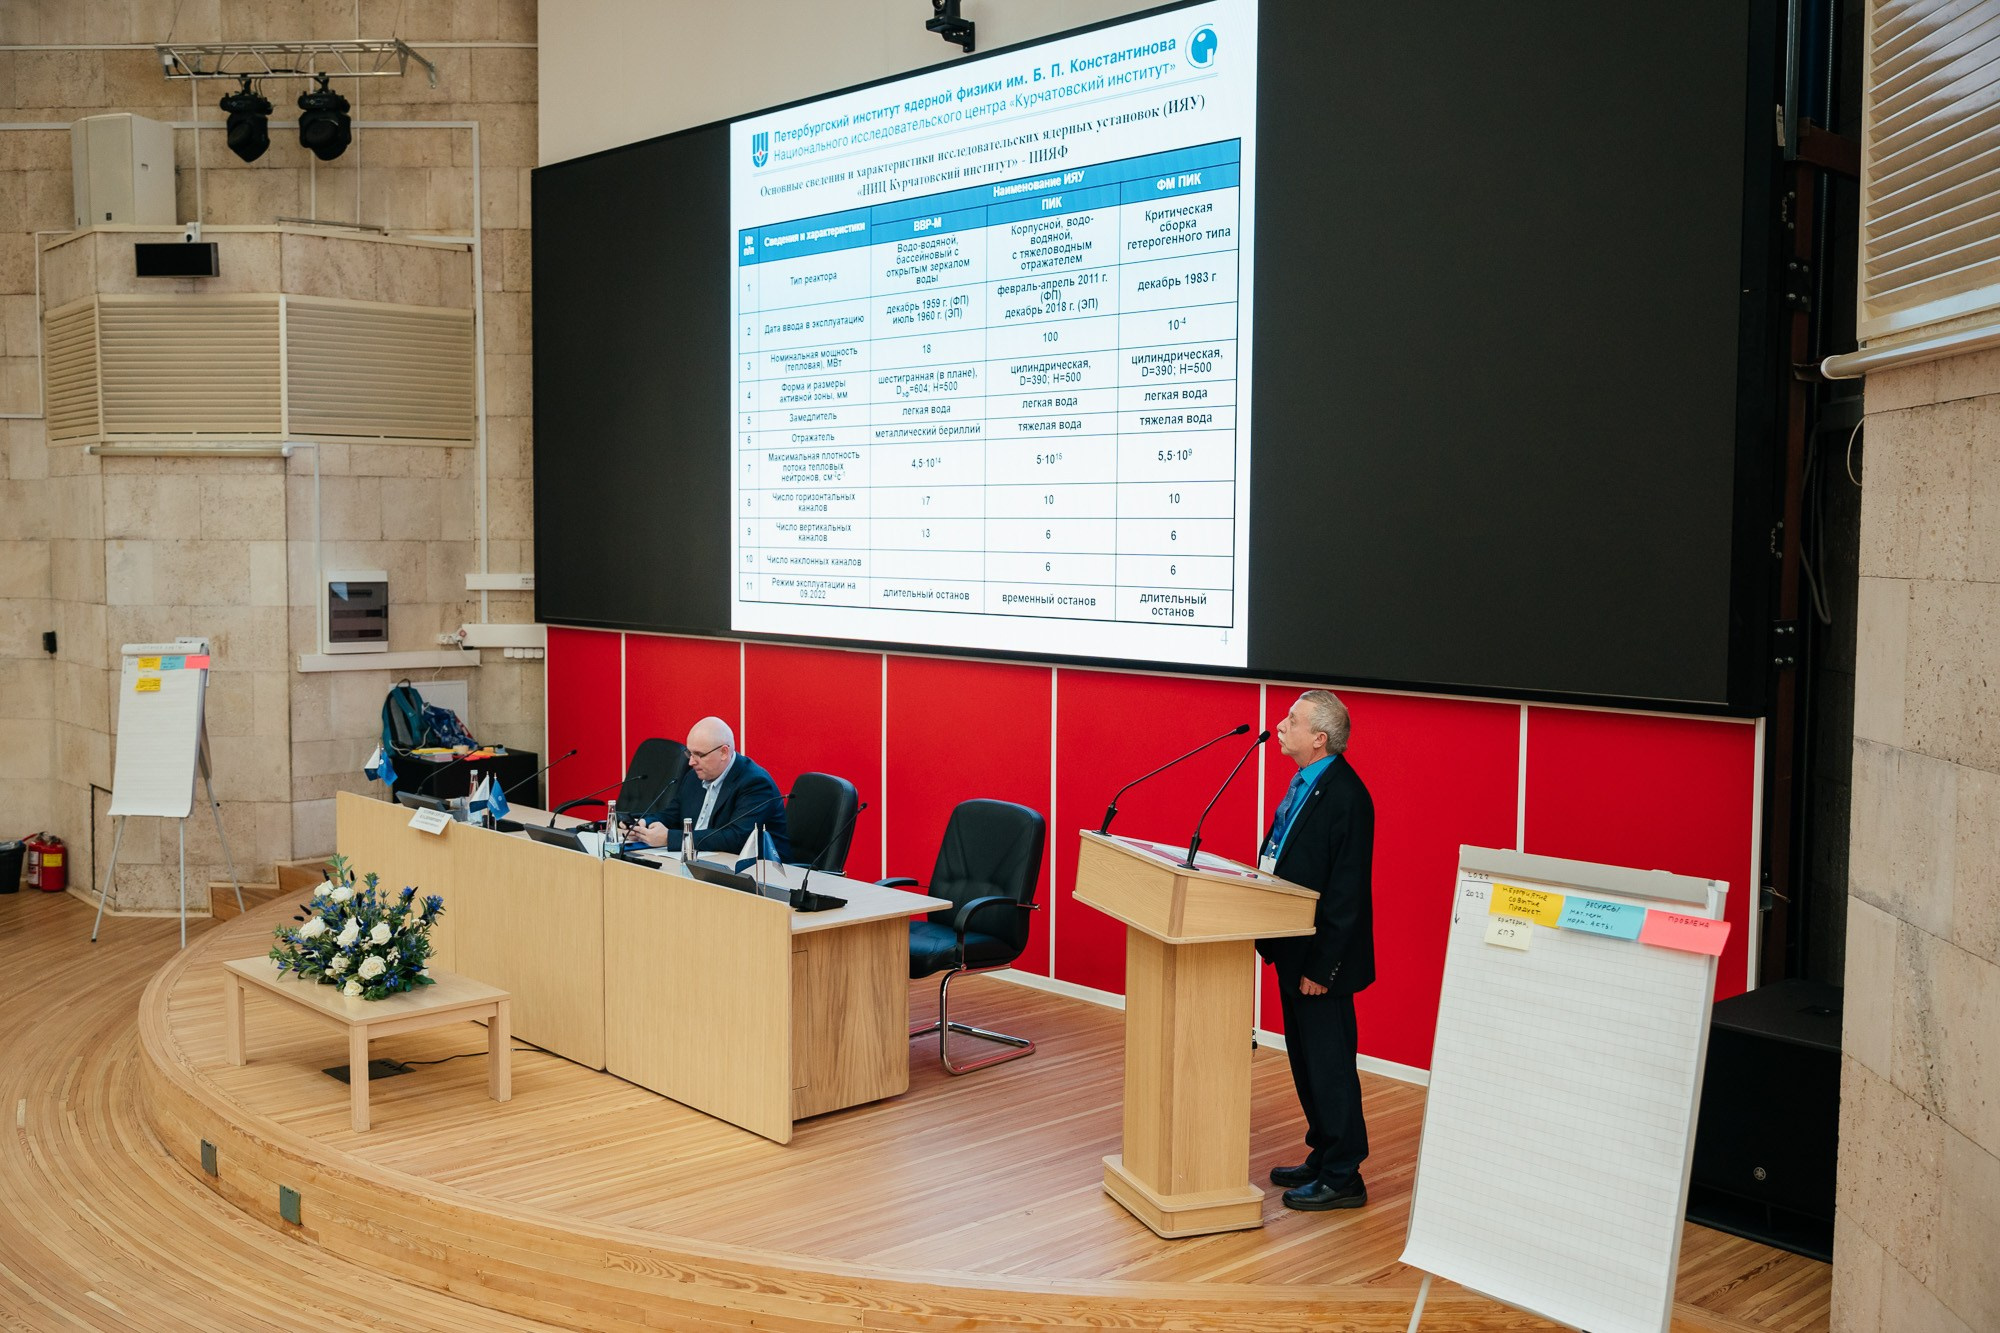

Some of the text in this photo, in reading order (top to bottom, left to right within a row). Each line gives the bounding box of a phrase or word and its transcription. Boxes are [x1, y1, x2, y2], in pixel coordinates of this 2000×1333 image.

[774, 38, 1176, 142] Петербургский институт ядерной физики им. Б. П. Константинова
[774, 62, 1175, 160] Национального исследовательского центра «Курчатовский институт»
[760, 182, 803, 196] Основные
[805, 172, 844, 187] сведения
[856, 154, 934, 179] характеристики
[938, 133, 1039, 160] исследовательских
[1042, 122, 1092, 139] ядерных
[1096, 107, 1159, 132] установок
[1163, 94, 1205, 117] (ИЯУ)
[889, 169, 959, 191] Курчатовский
[963, 159, 1017, 176] институт»
[1029, 145, 1068, 163] ПИЯФ
[993, 170, 1084, 197] Наименование ИЯУ
[1156, 172, 1201, 190] ФМ ПИК
[1041, 196, 1062, 210] ПИК
[1145, 203, 1212, 222] Критическая
[913, 216, 941, 231] ВВР-М
[1011, 215, 1093, 236] Корпусной, водо-
[1159, 219, 1197, 232] сборка
[763, 233, 799, 247] Сведения
[806, 222, 865, 241] характеристики
[1030, 228, 1072, 244] водяной,
[1127, 227, 1230, 250] гетерогенного типа
[897, 234, 958, 253] Водо-водяной,
[1019, 241, 1091, 258] тяжеловодным
[896, 247, 952, 264] бассейновый
[1020, 254, 1082, 271] отражателем
[886, 258, 969, 277] открытым зеркалом
[790, 272, 837, 285] Тип реактора
[916, 274, 938, 284] воды
[997, 278, 1075, 297] февраль-апрель
[1077, 272, 1098, 285] 2011
[1137, 276, 1181, 291] декабрь
[1184, 271, 1208, 284] 1983
[1040, 289, 1061, 303] (ФП)
[886, 303, 919, 314] декабрь
[922, 298, 940, 309] 1959
[950, 294, 969, 308] (ФП)
[1004, 305, 1042, 319] декабрь
[1045, 301, 1066, 313] 2018
[1077, 297, 1098, 312] (ЭП)
[892, 315, 914, 324] июль
[917, 310, 935, 321] 1960
[944, 307, 962, 320] (ЭП)
[764, 324, 780, 334] Дата
[782, 322, 803, 331] ввода
[811, 315, 864, 328] эксплуатацию
[1042, 331, 1058, 342] 100
[770, 347, 857, 362] Номинальная мощность
[1131, 349, 1223, 365] цилиндрическая,
[826, 358, 842, 367] МВт
[1010, 359, 1090, 374] цилиндрическая,
[878, 372, 934, 384] шестигранная
[947, 367, 977, 378] плане),
[781, 383, 804, 392] Форма
[813, 380, 845, 391] размеры
[779, 391, 811, 402] активной
[1144, 389, 1207, 401] легкая вода
[1022, 397, 1077, 408] легкая вода
[789, 412, 837, 422] Замедлитель
[902, 405, 950, 415] легкая вода
[1018, 420, 1081, 431] тяжелая вода
[1139, 413, 1212, 425] тяжелая вода
[875, 424, 980, 437] металлический бериллий
[791, 433, 834, 444] Отражатель
[768, 451, 859, 461] Максимальная плотность
[808, 463, 843, 471] тепловых
[772, 493, 855, 502] Число горизонтальных
[1168, 492, 1180, 503] 10
[799, 524, 851, 532] вертикальных
[766, 555, 861, 566] Число наклонных каналов
[772, 577, 794, 586] Режим
[796, 580, 845, 589] эксплуатации
[883, 588, 969, 600] длительный останов
[1002, 593, 1096, 606] временный останов
[1139, 593, 1206, 604] длительный
[1151, 607, 1194, 617] останов
